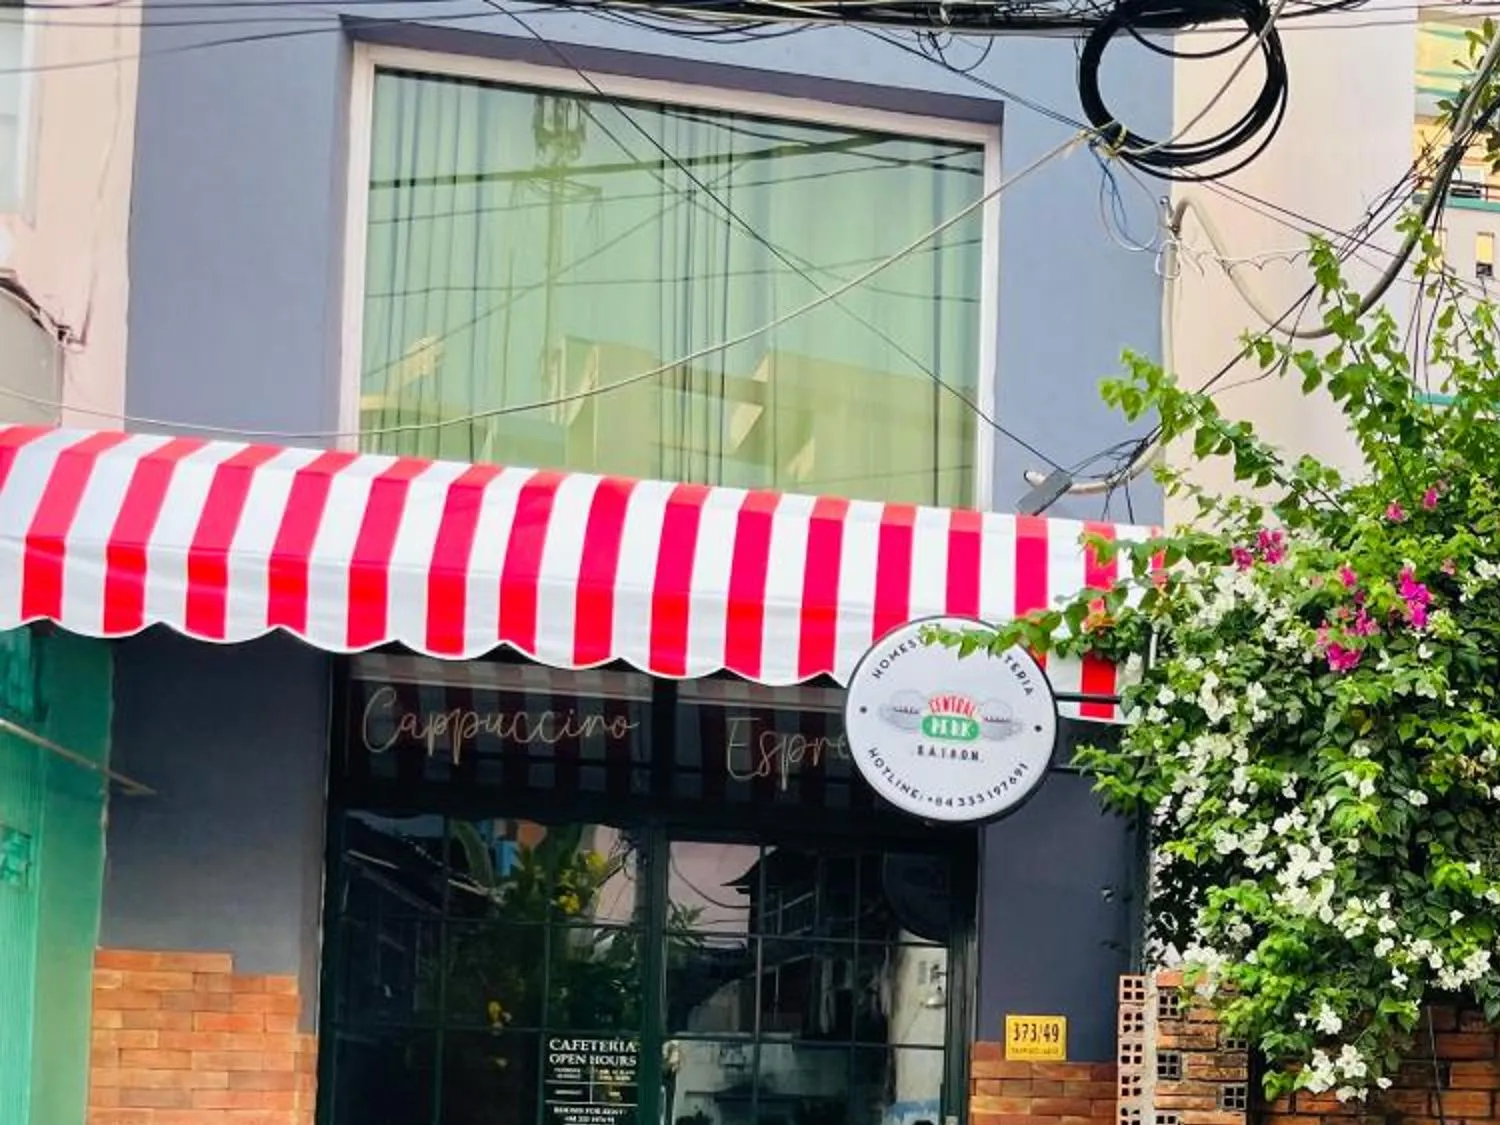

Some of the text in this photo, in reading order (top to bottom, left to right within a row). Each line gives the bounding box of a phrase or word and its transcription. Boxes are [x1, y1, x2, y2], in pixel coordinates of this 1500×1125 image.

[362, 686, 640, 765] Cappuccino
[931, 716, 973, 737] PERK
[726, 716, 849, 792] Espre
[549, 1038, 637, 1053] CAFETERIA
[549, 1053, 637, 1067] OPEN HOURS
